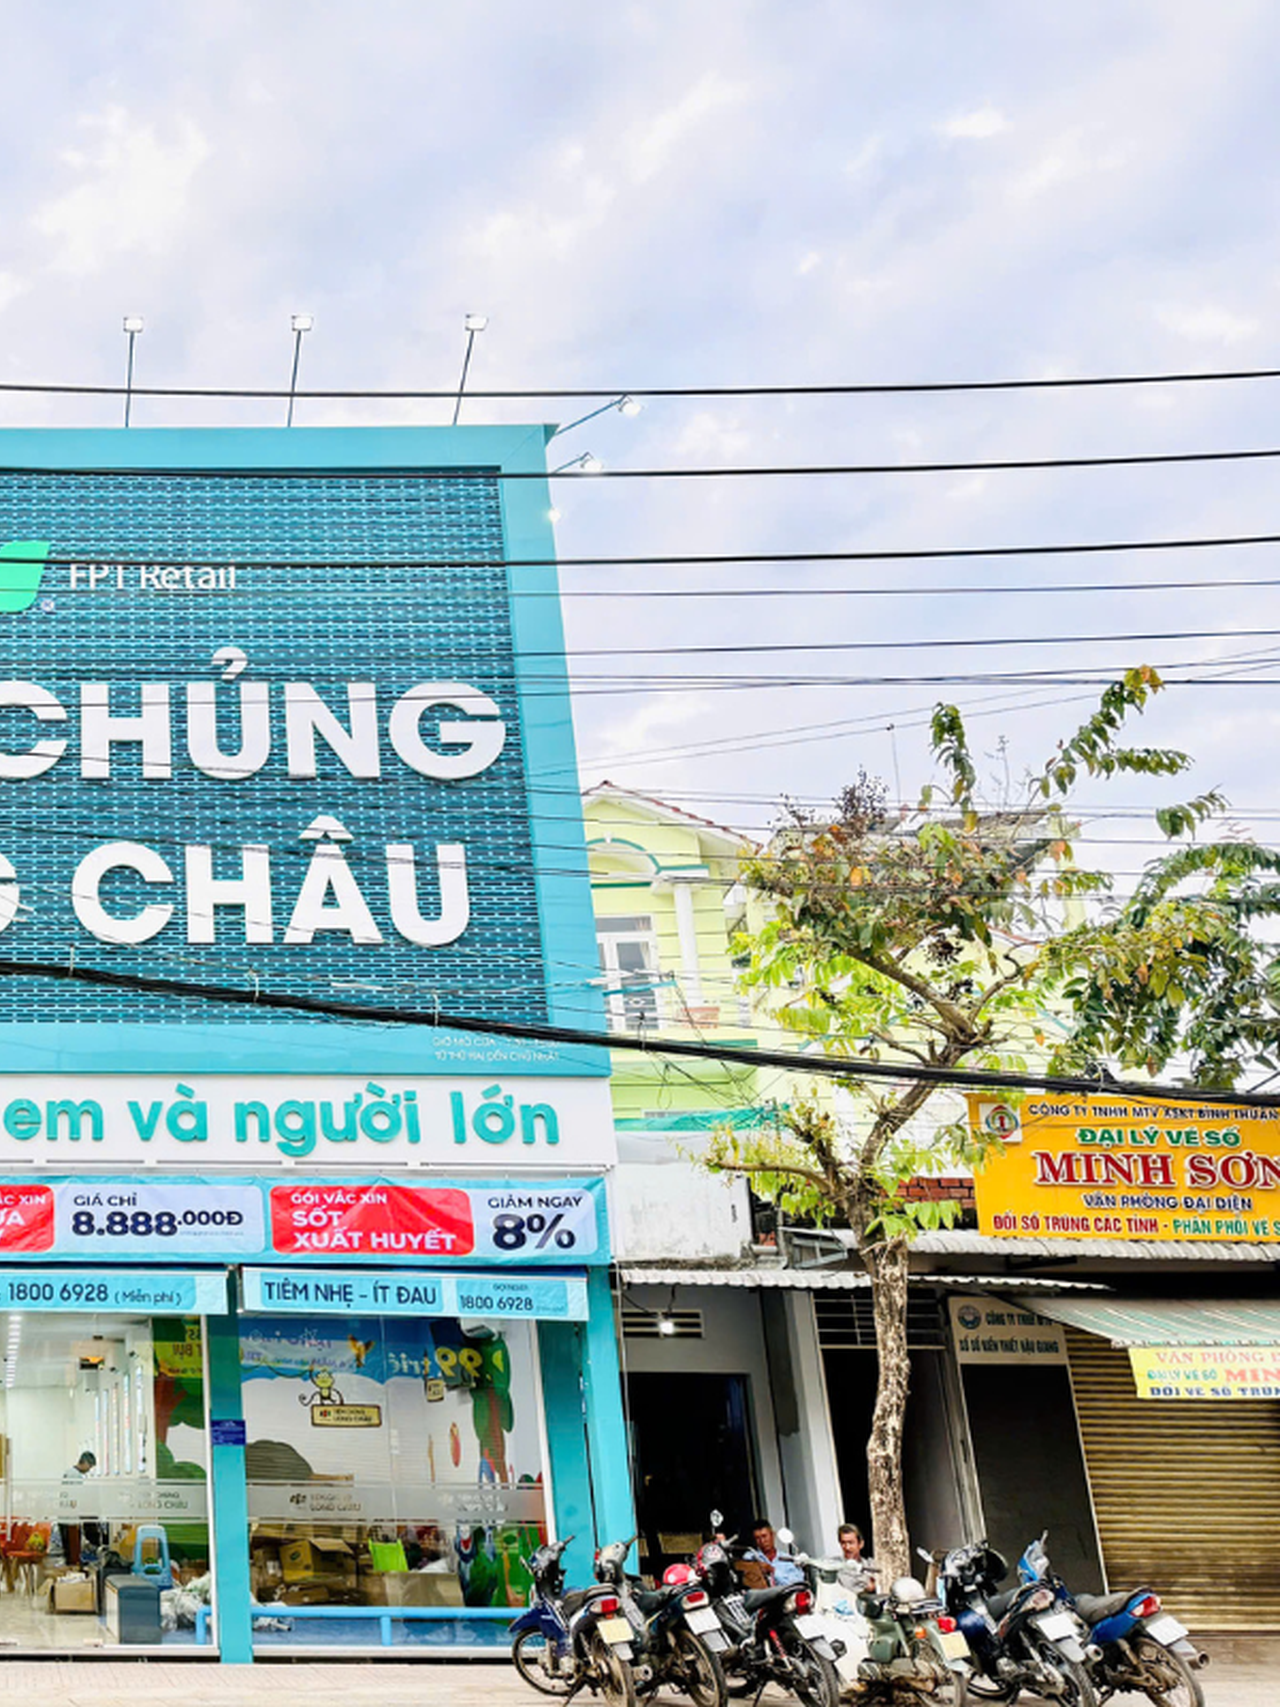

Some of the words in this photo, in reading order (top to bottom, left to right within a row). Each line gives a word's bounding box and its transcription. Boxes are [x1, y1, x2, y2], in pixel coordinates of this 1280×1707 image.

[69, 561, 127, 589] FPT
[140, 561, 237, 589] Retail
[72, 815, 472, 946] CHÂU
[4, 1099, 104, 1141] em
[127, 1083, 208, 1142] và
[234, 1082, 420, 1157] người
[449, 1084, 559, 1145] lớn
[1028, 1102, 1070, 1117] CÔNG
[1073, 1105, 1088, 1117] TY
[1092, 1105, 1128, 1117] TNHH
[1132, 1106, 1160, 1118] MTV
[1198, 1104, 1230, 1119] BÌNH
[1077, 1128, 1125, 1149] ĐẠI
[1129, 1126, 1160, 1145] LÝ
[1164, 1126, 1200, 1146] VÉ
[1204, 1125, 1241, 1147] SỐ
[1032, 1151, 1176, 1187] MINH
[1187, 1151, 1280, 1188] SƠN
[18, 1193, 46, 1205] XIN
[73, 1192, 104, 1207] GIÁ
[107, 1191, 138, 1207] CHỈ
[291, 1191, 320, 1205] GÓI
[361, 1192, 388, 1205] XIN
[488, 1194, 534, 1209] GIẢM
[537, 1196, 584, 1209] NGAY
[1082, 1190, 1117, 1208] VĂN
[1120, 1192, 1179, 1210] PHÒNG
[1183, 1196, 1211, 1214] ĐẠI
[1214, 1192, 1253, 1215] DIỆN
[292, 1205, 344, 1227] SỐT
[1020, 1210, 1040, 1231] SỐ
[1043, 1213, 1091, 1232] TRÚNG
[1093, 1213, 1123, 1233] CÁC
[1125, 1212, 1160, 1233] TỈNH
[1172, 1215, 1213, 1235] PHÂN
[1215, 1213, 1249, 1236] PHỐI
[1251, 1217, 1271, 1237] VÉ
[294, 1228, 364, 1249] XUẤT
[371, 1228, 457, 1250] HUYẾT
[492, 1213, 576, 1251] 8%
[8, 1283, 54, 1302] 1800
[59, 1283, 109, 1302] 6928
[264, 1278, 309, 1302] TIÊM
[314, 1283, 353, 1308] NHẸ
[373, 1280, 390, 1303] ÍT
[396, 1284, 437, 1305] ĐAU
[460, 1295, 494, 1310] 1800
[496, 1296, 534, 1311] 6928
